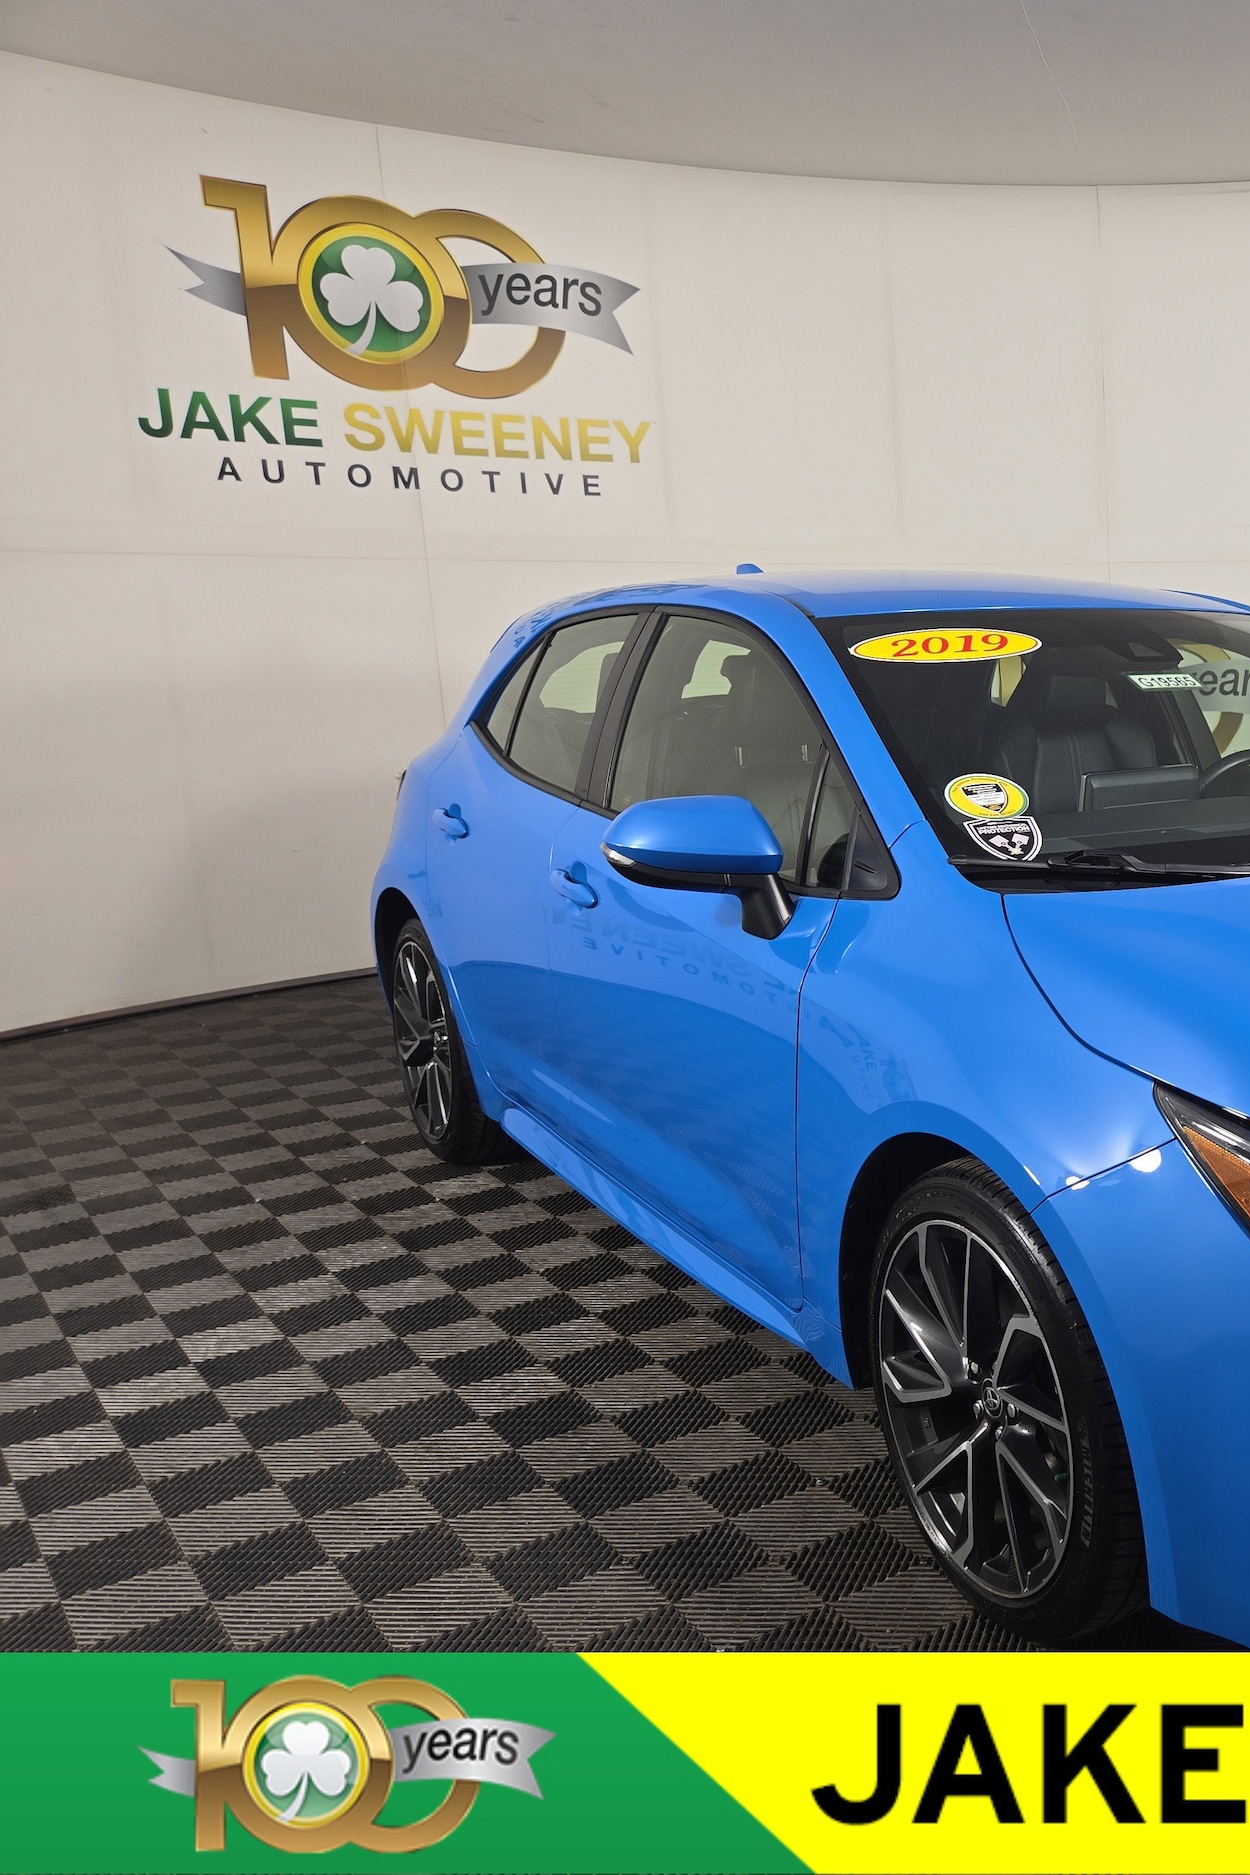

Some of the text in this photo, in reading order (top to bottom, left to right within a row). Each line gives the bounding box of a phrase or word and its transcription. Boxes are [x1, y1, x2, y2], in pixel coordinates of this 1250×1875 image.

[478, 270, 603, 317] years
[138, 387, 652, 464] JAKE SWEENEY
[217, 456, 601, 497] AUTOMOTIVE
[891, 634, 1009, 657] 2019
[1138, 676, 1197, 688] G19565
